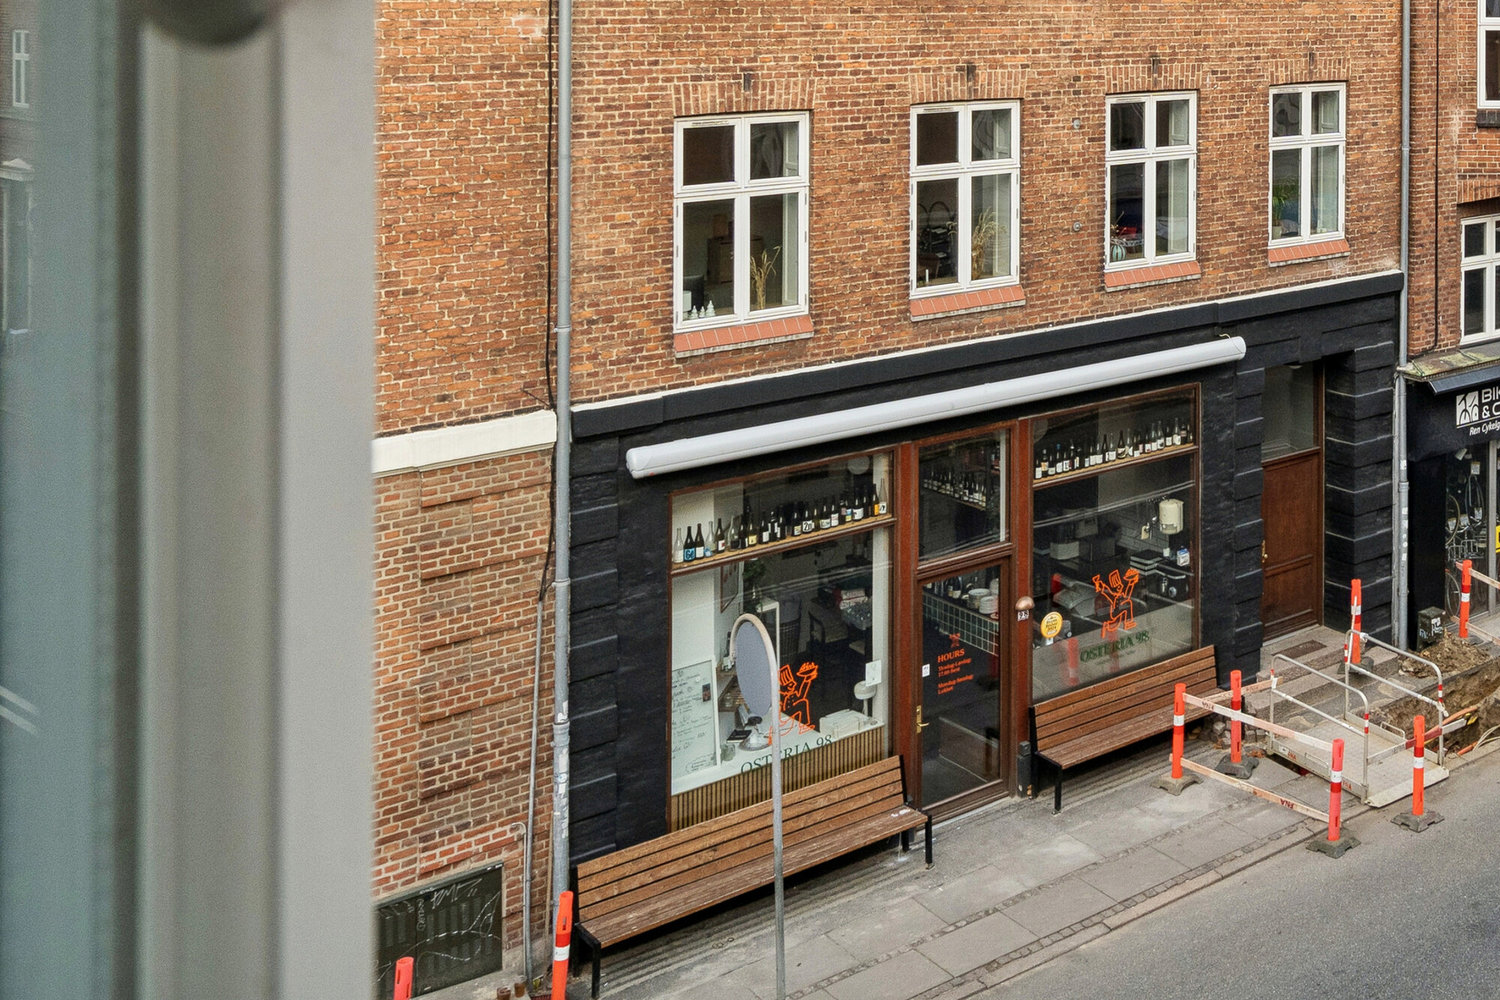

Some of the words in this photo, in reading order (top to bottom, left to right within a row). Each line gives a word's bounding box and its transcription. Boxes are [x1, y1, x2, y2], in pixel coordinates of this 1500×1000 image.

[937, 648, 965, 663] HOURS
[1080, 637, 1134, 662] OSTERIA
[1135, 630, 1150, 642] 98
[740, 742, 812, 774] OSTRIA
[816, 734, 832, 748] 98
